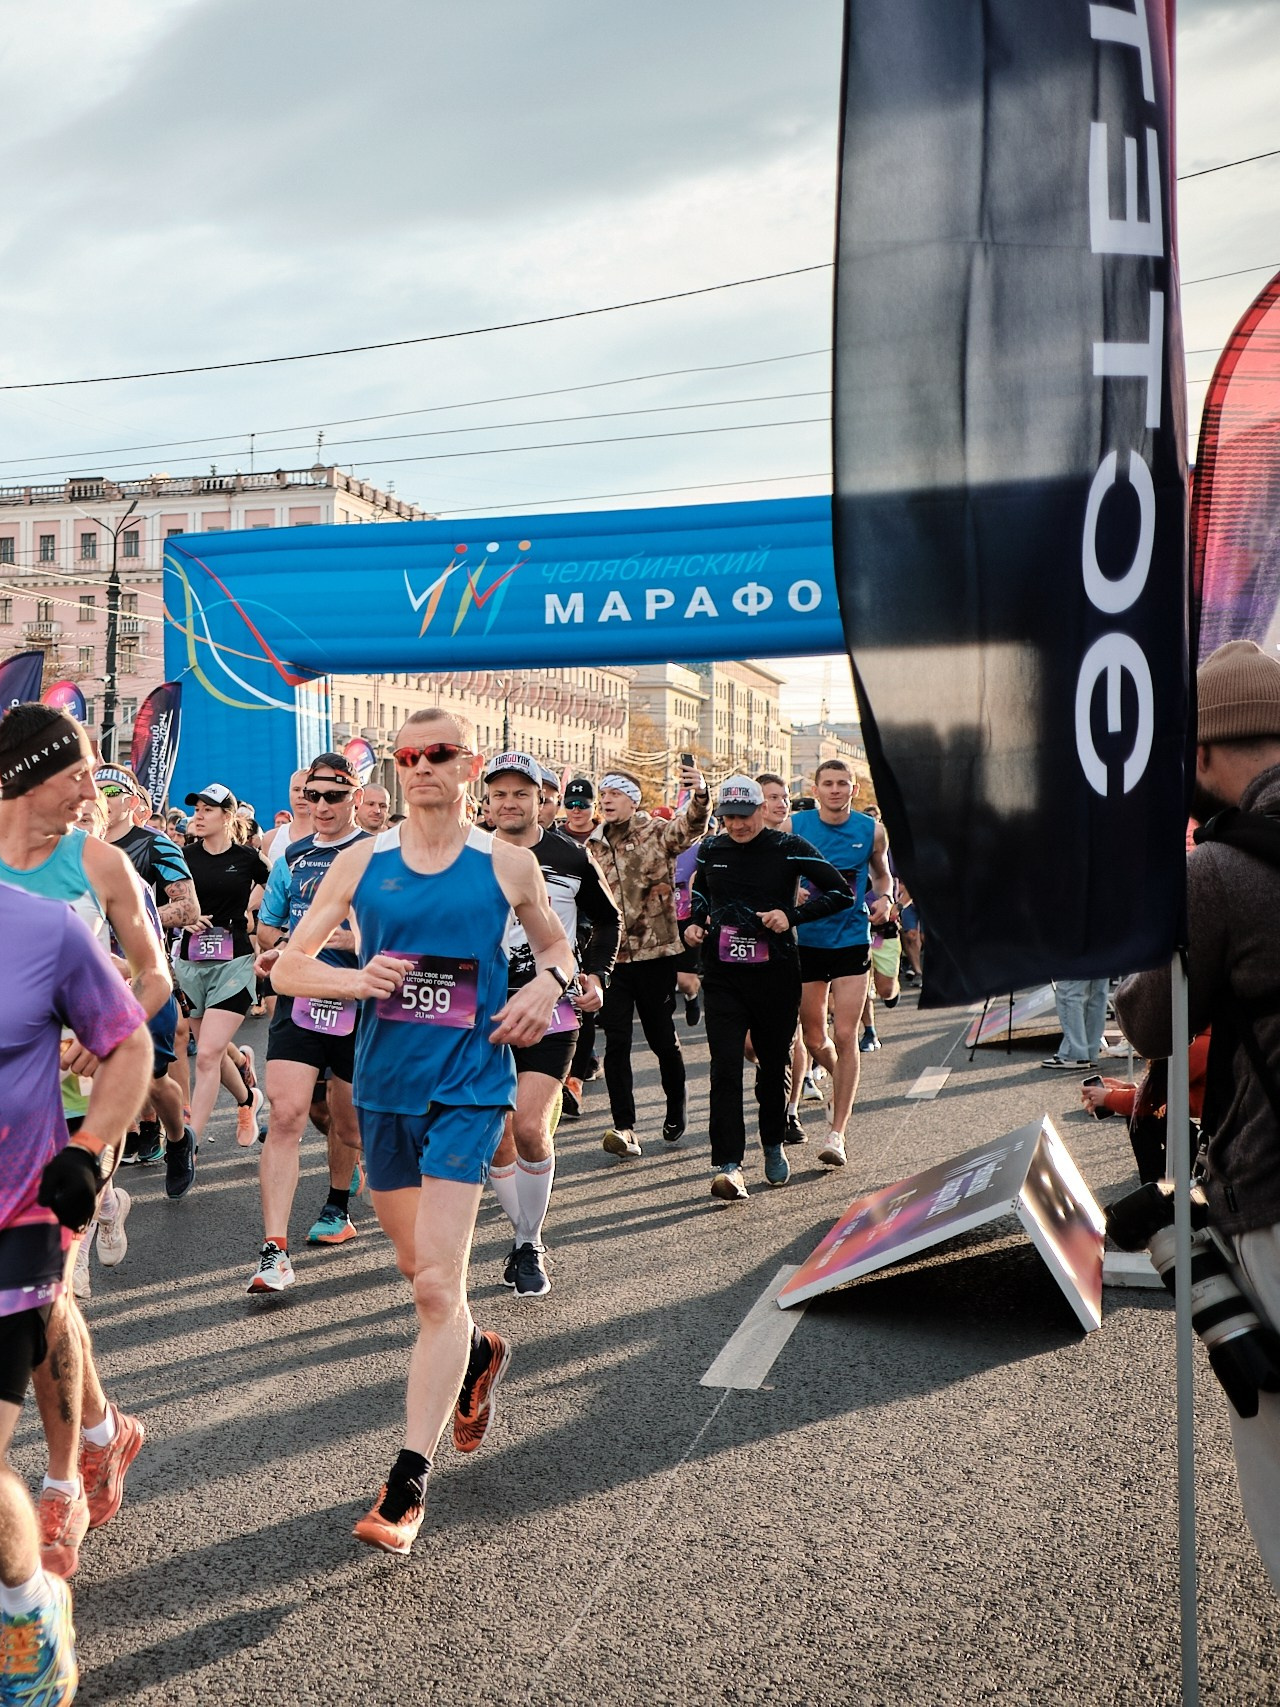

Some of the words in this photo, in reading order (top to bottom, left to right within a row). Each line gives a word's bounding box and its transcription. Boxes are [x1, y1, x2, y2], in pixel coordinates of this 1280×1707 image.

[541, 544, 772, 584] челябинский
[544, 579, 840, 625] МАРАФО
[147, 725, 160, 797] елябинский
[495, 754, 531, 767] TURGOYAK
[199, 941, 222, 955] 357
[729, 944, 756, 958] 267
[401, 984, 451, 1014] 599
[310, 1007, 338, 1028] 441
